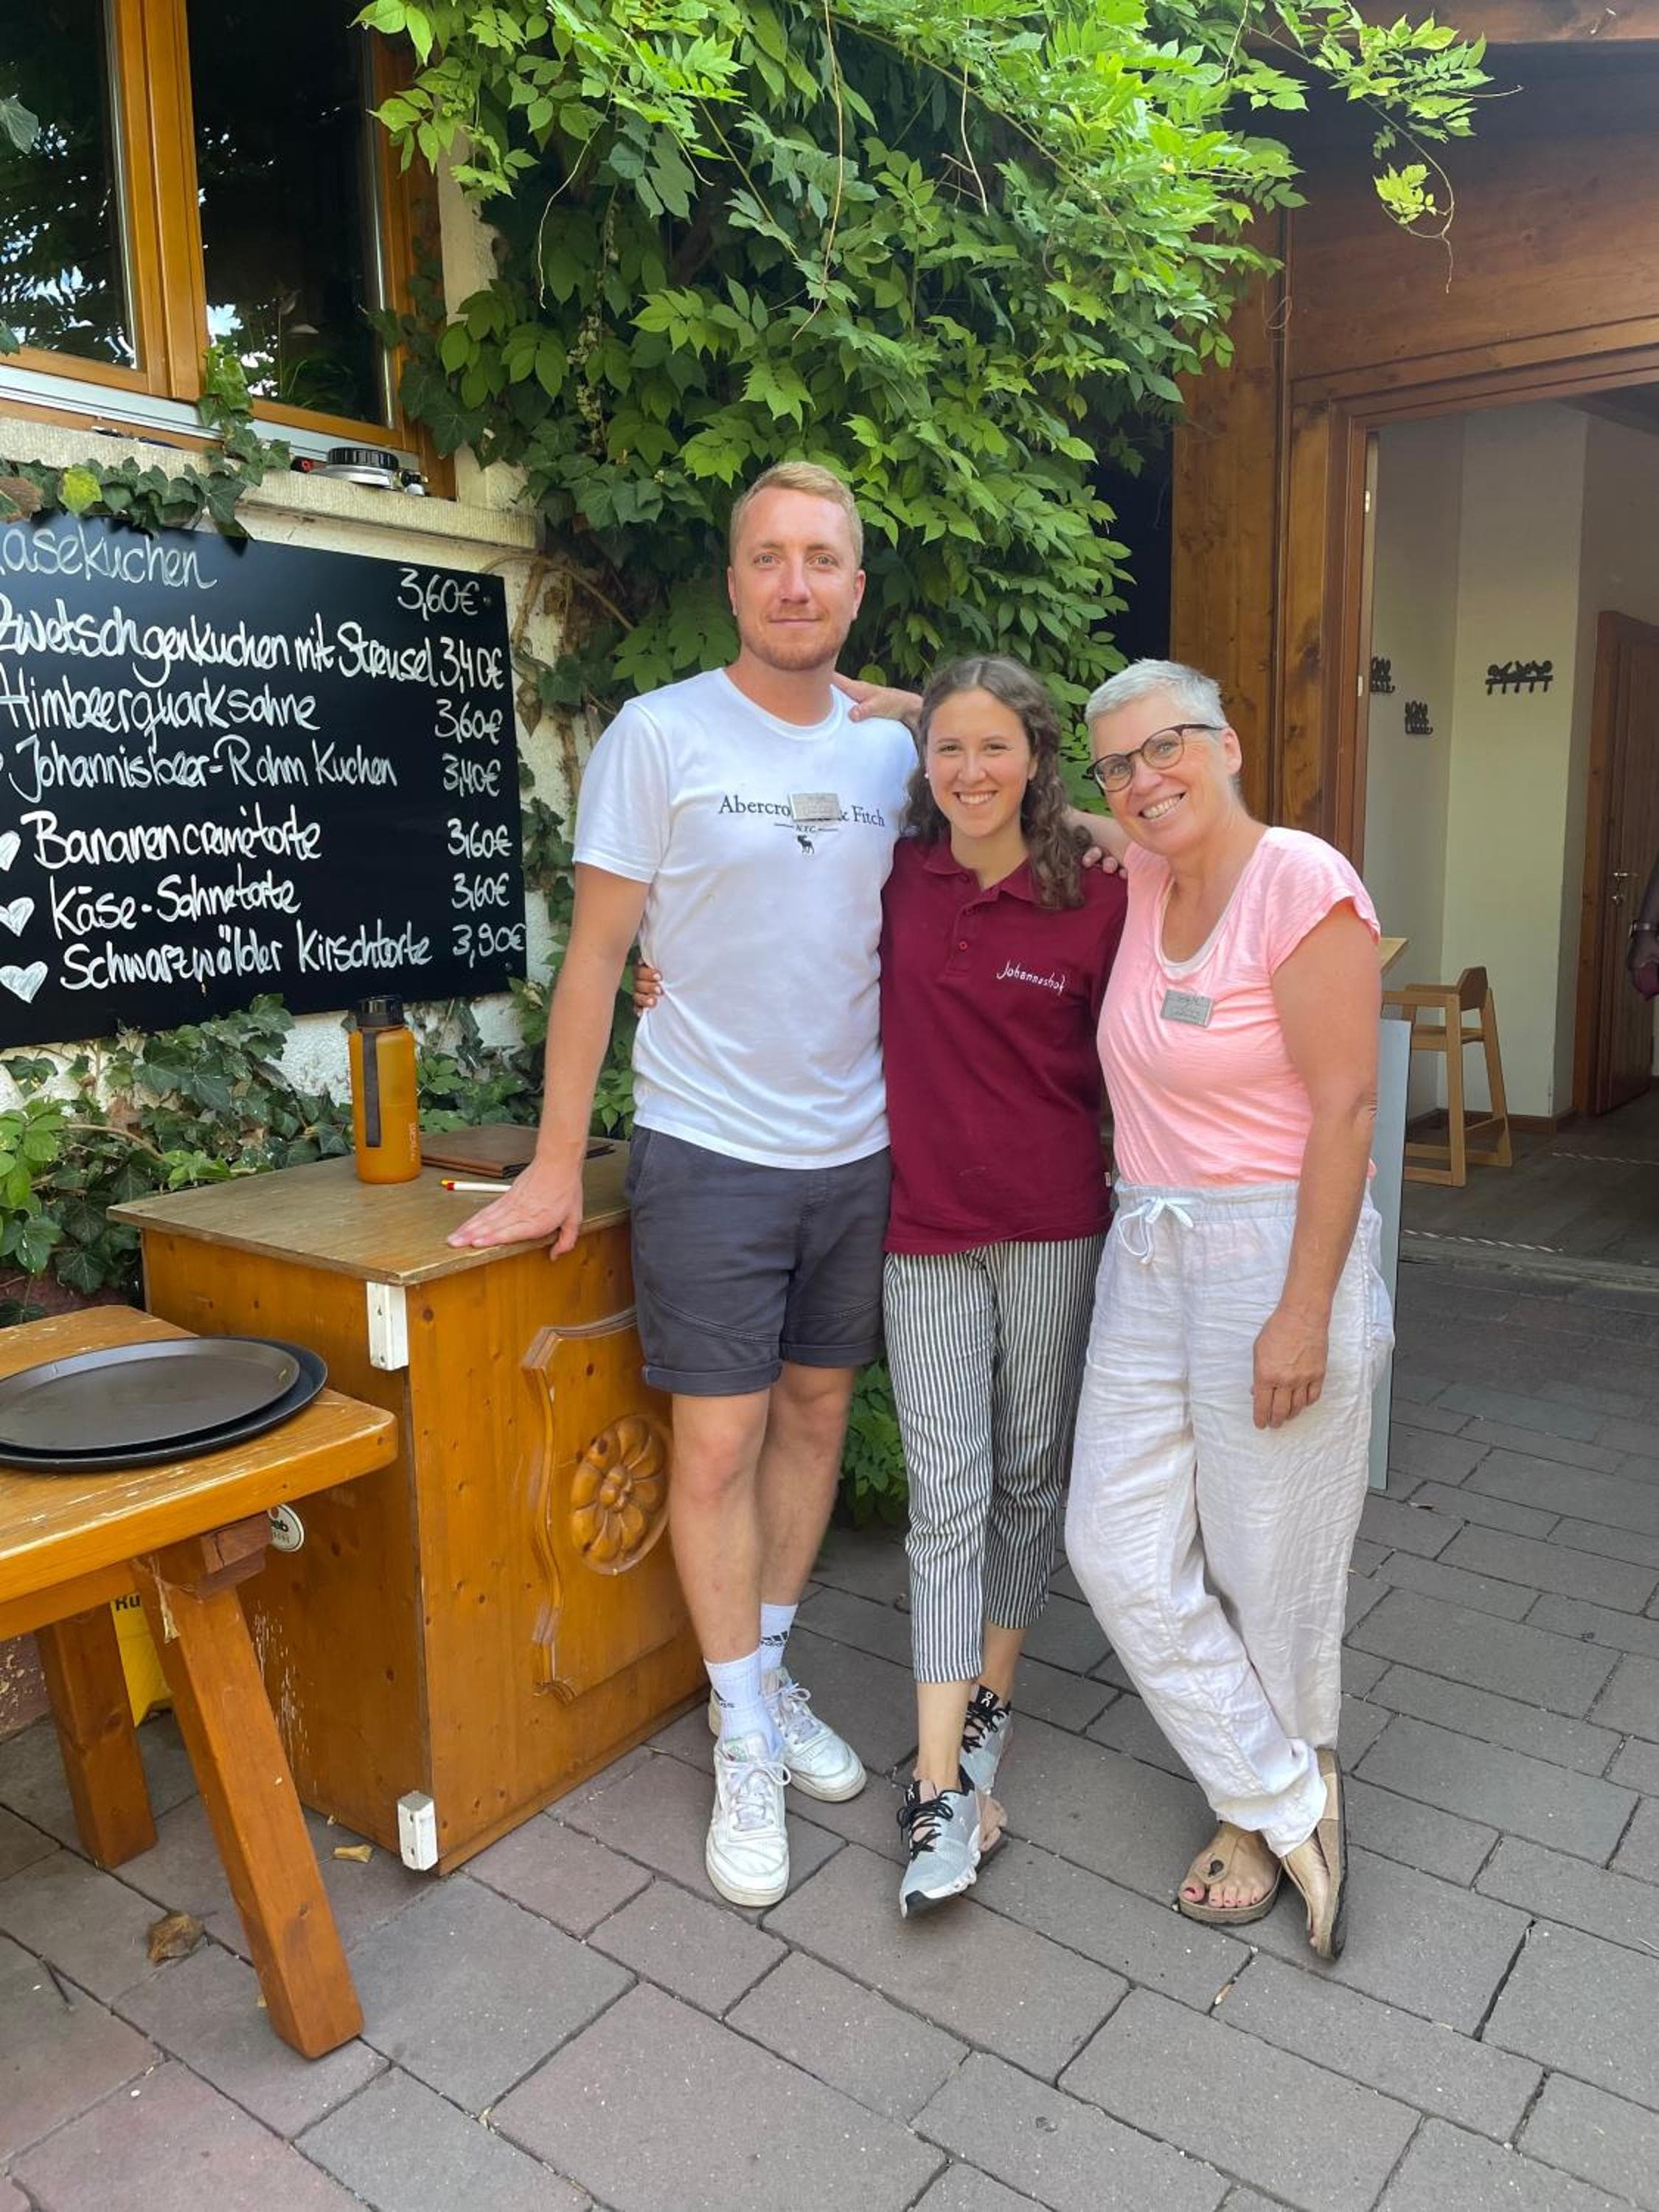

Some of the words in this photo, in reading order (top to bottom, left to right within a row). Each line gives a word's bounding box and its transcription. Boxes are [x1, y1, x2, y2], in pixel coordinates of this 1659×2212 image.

[0, 524, 218, 588] asekuchen
[398, 568, 479, 621] 3,60€
[295, 613, 335, 672] mit
[337, 622, 438, 688] Streusel
[440, 636, 504, 694] 3,40€
[434, 699, 504, 745] 3,60€
[312, 739, 397, 787] Kuchen
[442, 753, 501, 797] 3,40€
[718, 794, 791, 818] Abercro
[851, 804, 886, 827] Fitch
[447, 818, 512, 859] 3,60€
[451, 872, 510, 911] 3,60€
[60, 924, 283, 990] Schwarzwälder
[296, 918, 433, 973] Kirschtorte
[452, 922, 526, 968] 3,90€
